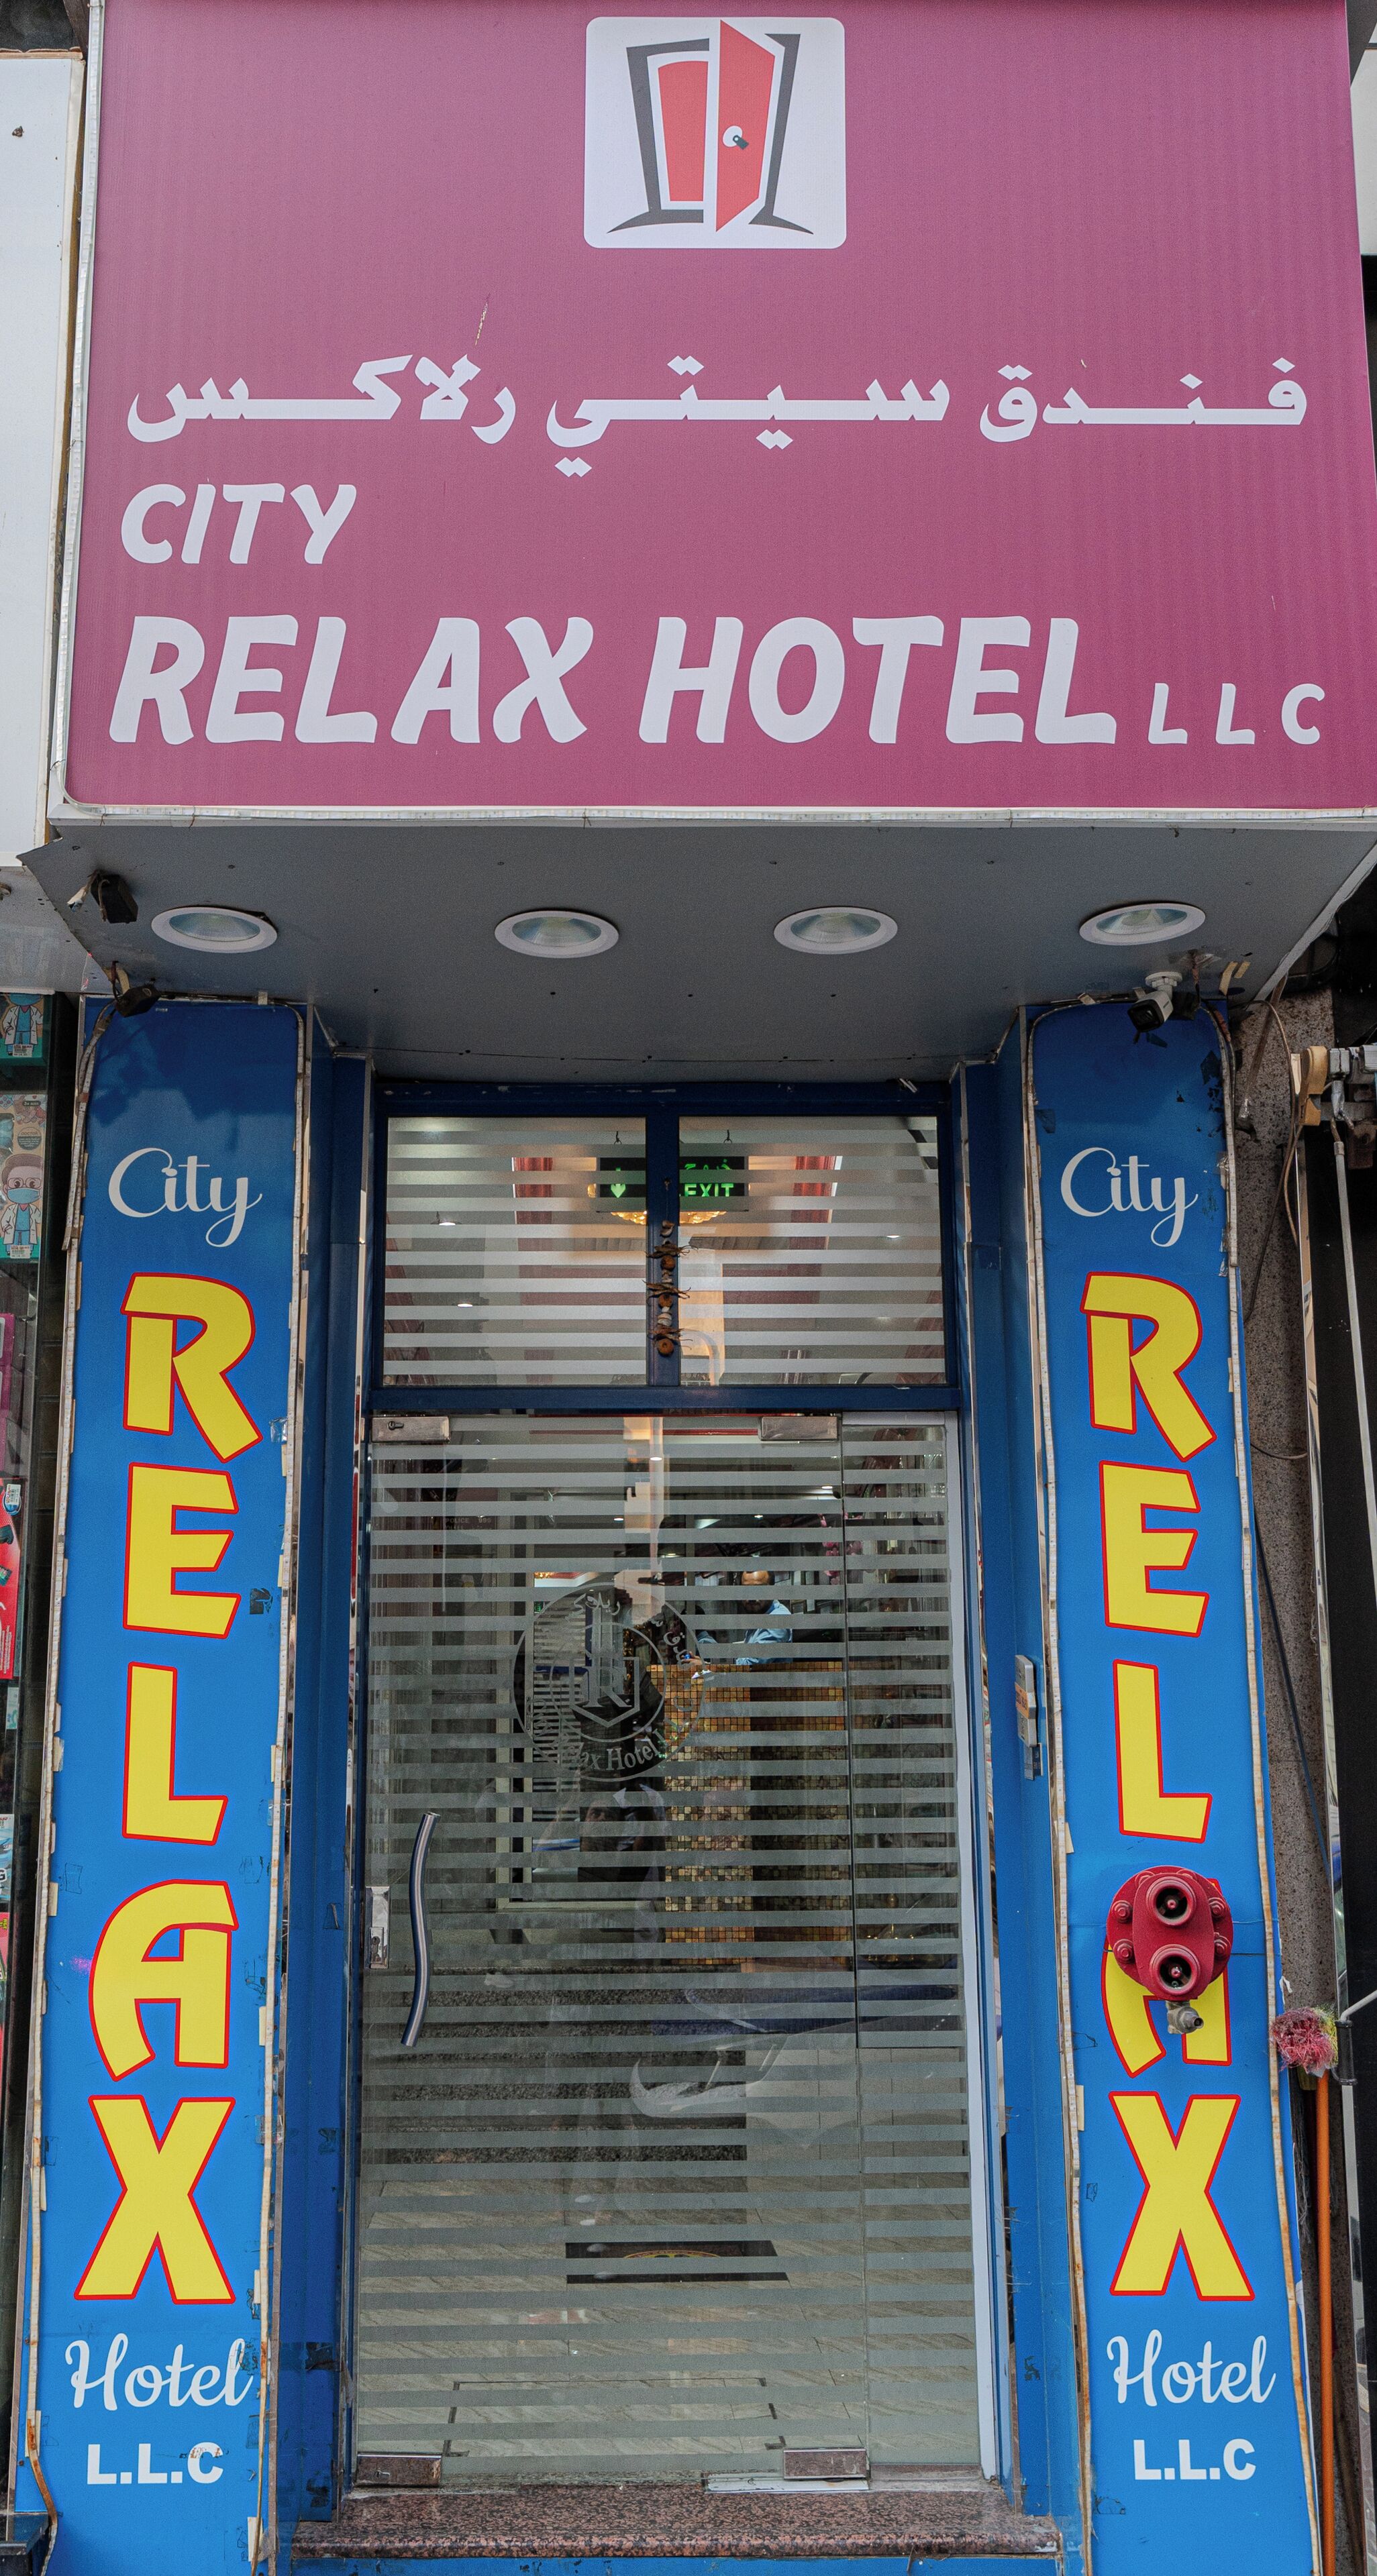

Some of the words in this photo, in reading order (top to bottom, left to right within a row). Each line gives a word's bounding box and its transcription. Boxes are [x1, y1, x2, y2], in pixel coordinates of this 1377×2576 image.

[126, 353, 516, 445] رلاكس
[545, 355, 950, 478] سيتي
[979, 356, 1308, 443] فندق
[120, 482, 357, 565] CITY
[109, 613, 594, 745] RELAX
[638, 614, 1117, 745] HOTEL
[108, 1147, 263, 1248] City
[684, 1183, 735, 1197] EXIT
[1061, 1146, 1198, 1248] City
[74, 1273, 262, 2304] RELAX
[606, 1735, 660, 1771] Hotel
[65, 2332, 254, 2411] Hotel
[1107, 2328, 1277, 2407] Hotel
[87, 2441, 224, 2485] L.L.C
[1133, 2438, 1256, 2481] L.L.C
